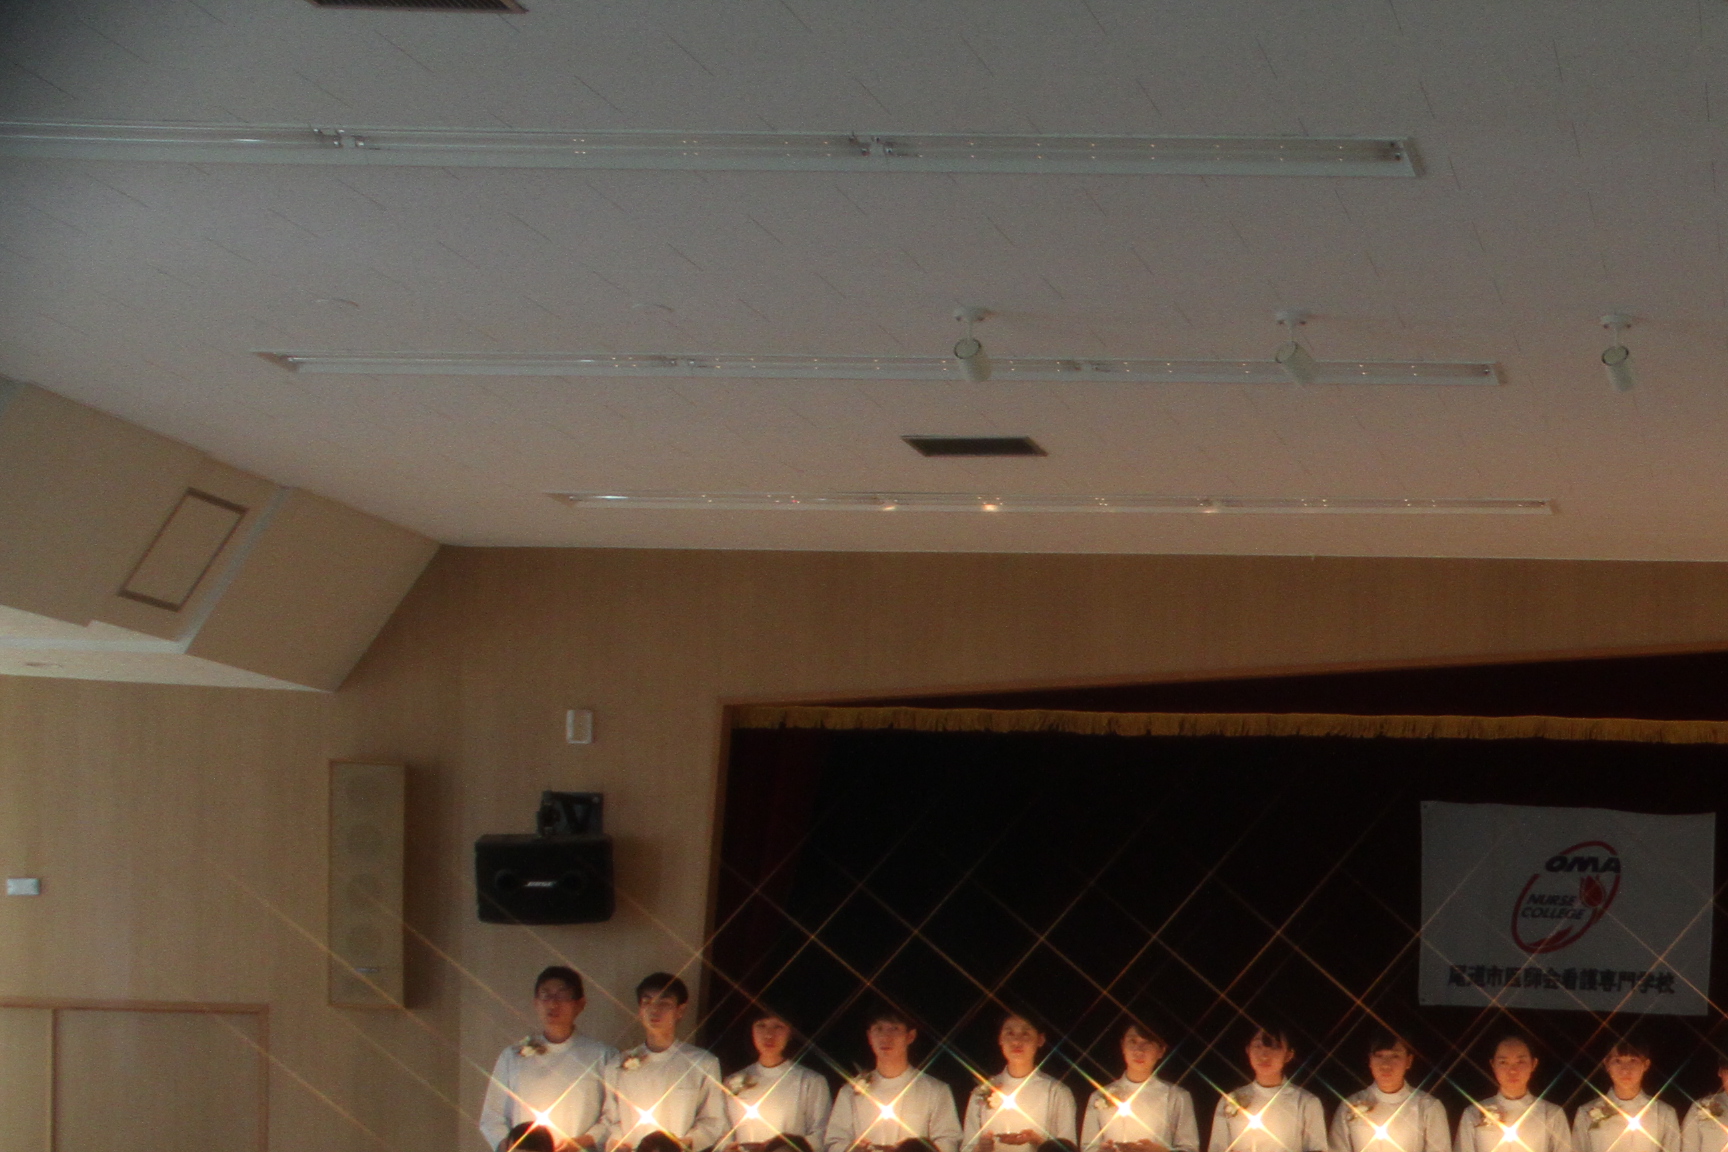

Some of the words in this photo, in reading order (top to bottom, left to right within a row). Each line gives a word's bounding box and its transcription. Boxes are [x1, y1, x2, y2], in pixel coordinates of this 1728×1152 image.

[1545, 855, 1621, 873] OMA
[1527, 894, 1577, 906] NURSE
[1521, 906, 1586, 919] COLLEGE
